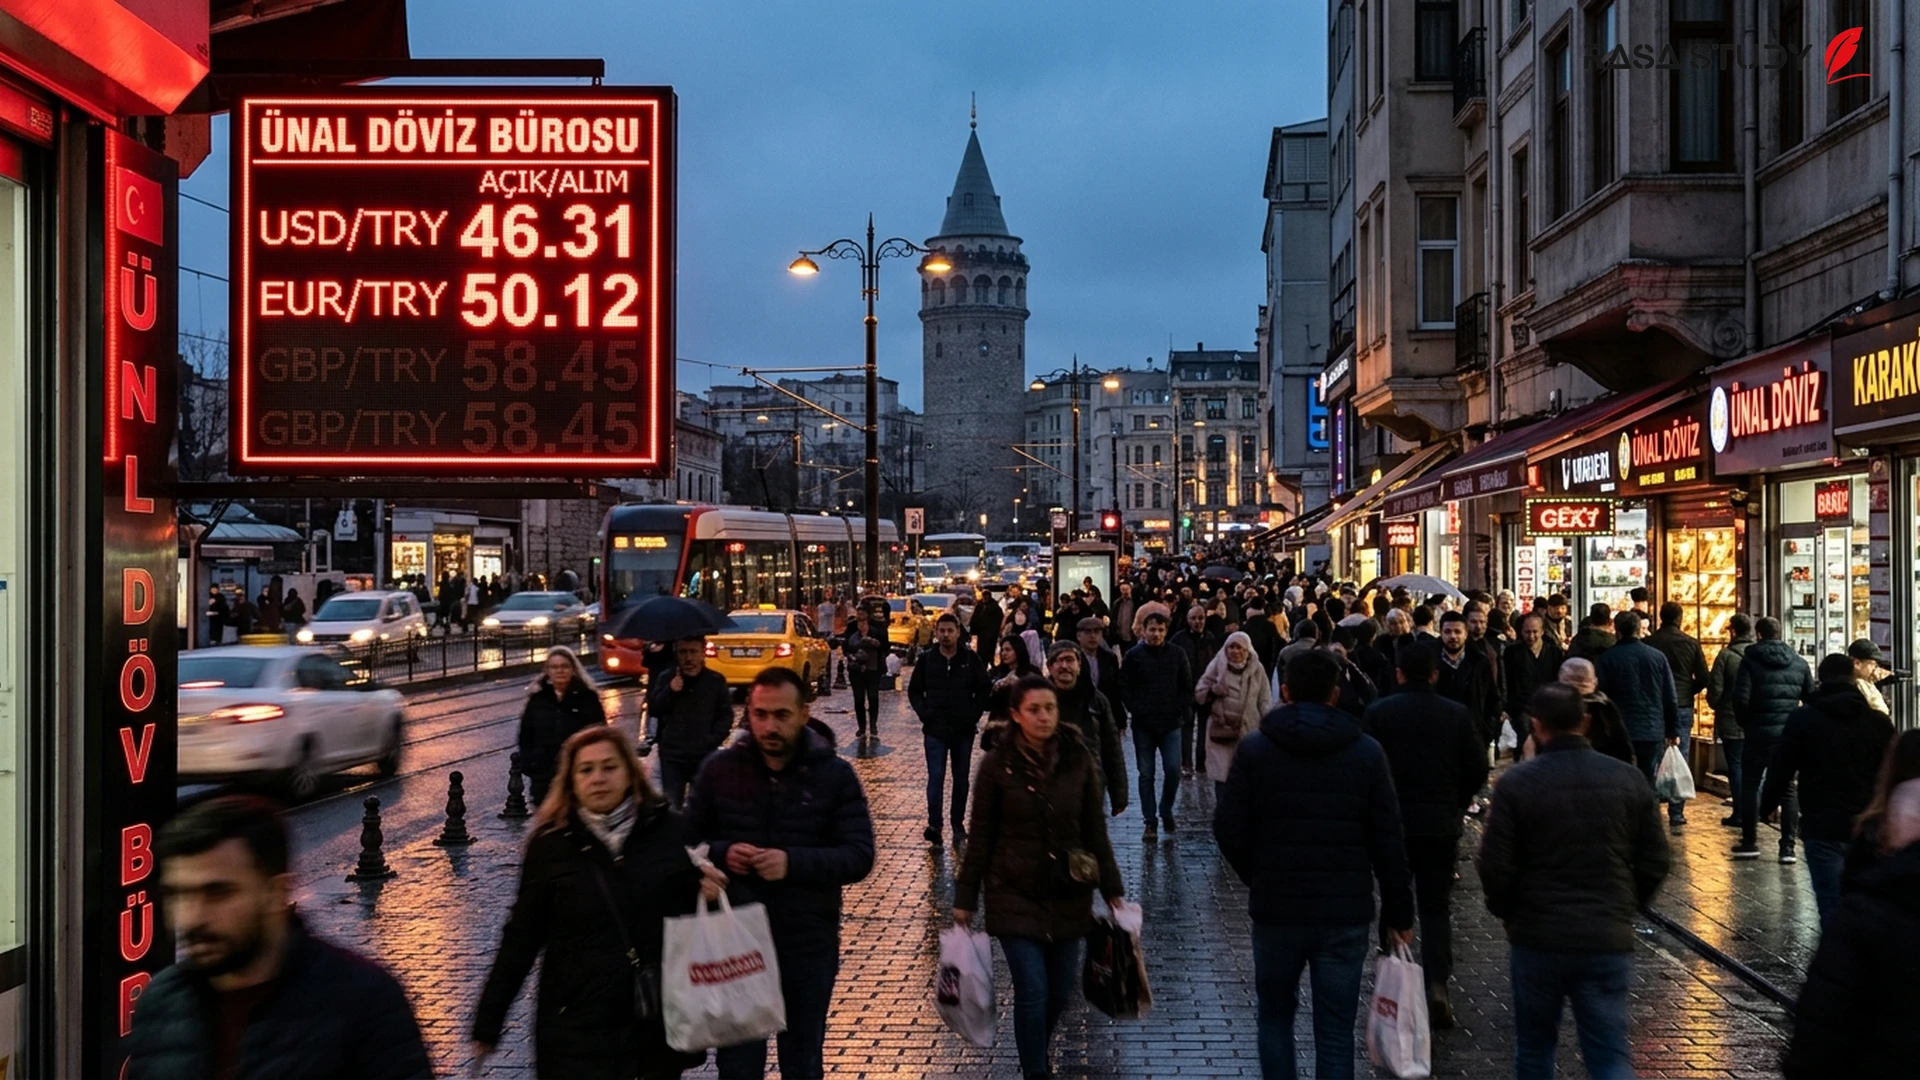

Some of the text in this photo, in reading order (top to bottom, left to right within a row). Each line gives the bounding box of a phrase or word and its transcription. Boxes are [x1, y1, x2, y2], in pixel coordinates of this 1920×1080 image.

[261, 109, 639, 152] ÜNAL DÖVİZ BÜROSU
[479, 168, 629, 198] AÇIK/ALIM
[260, 205, 631, 257] USD/TRY 46.31
[260, 273, 639, 327] EUR/TRY 50.12
[259, 340, 639, 392] GBP/TRY 58.45
[1731, 360, 1820, 437] ÜNAL DÖVİZ
[259, 402, 639, 454] GBP/TRY 58.45
[1664, 415, 1700, 461] DÖVİZ
